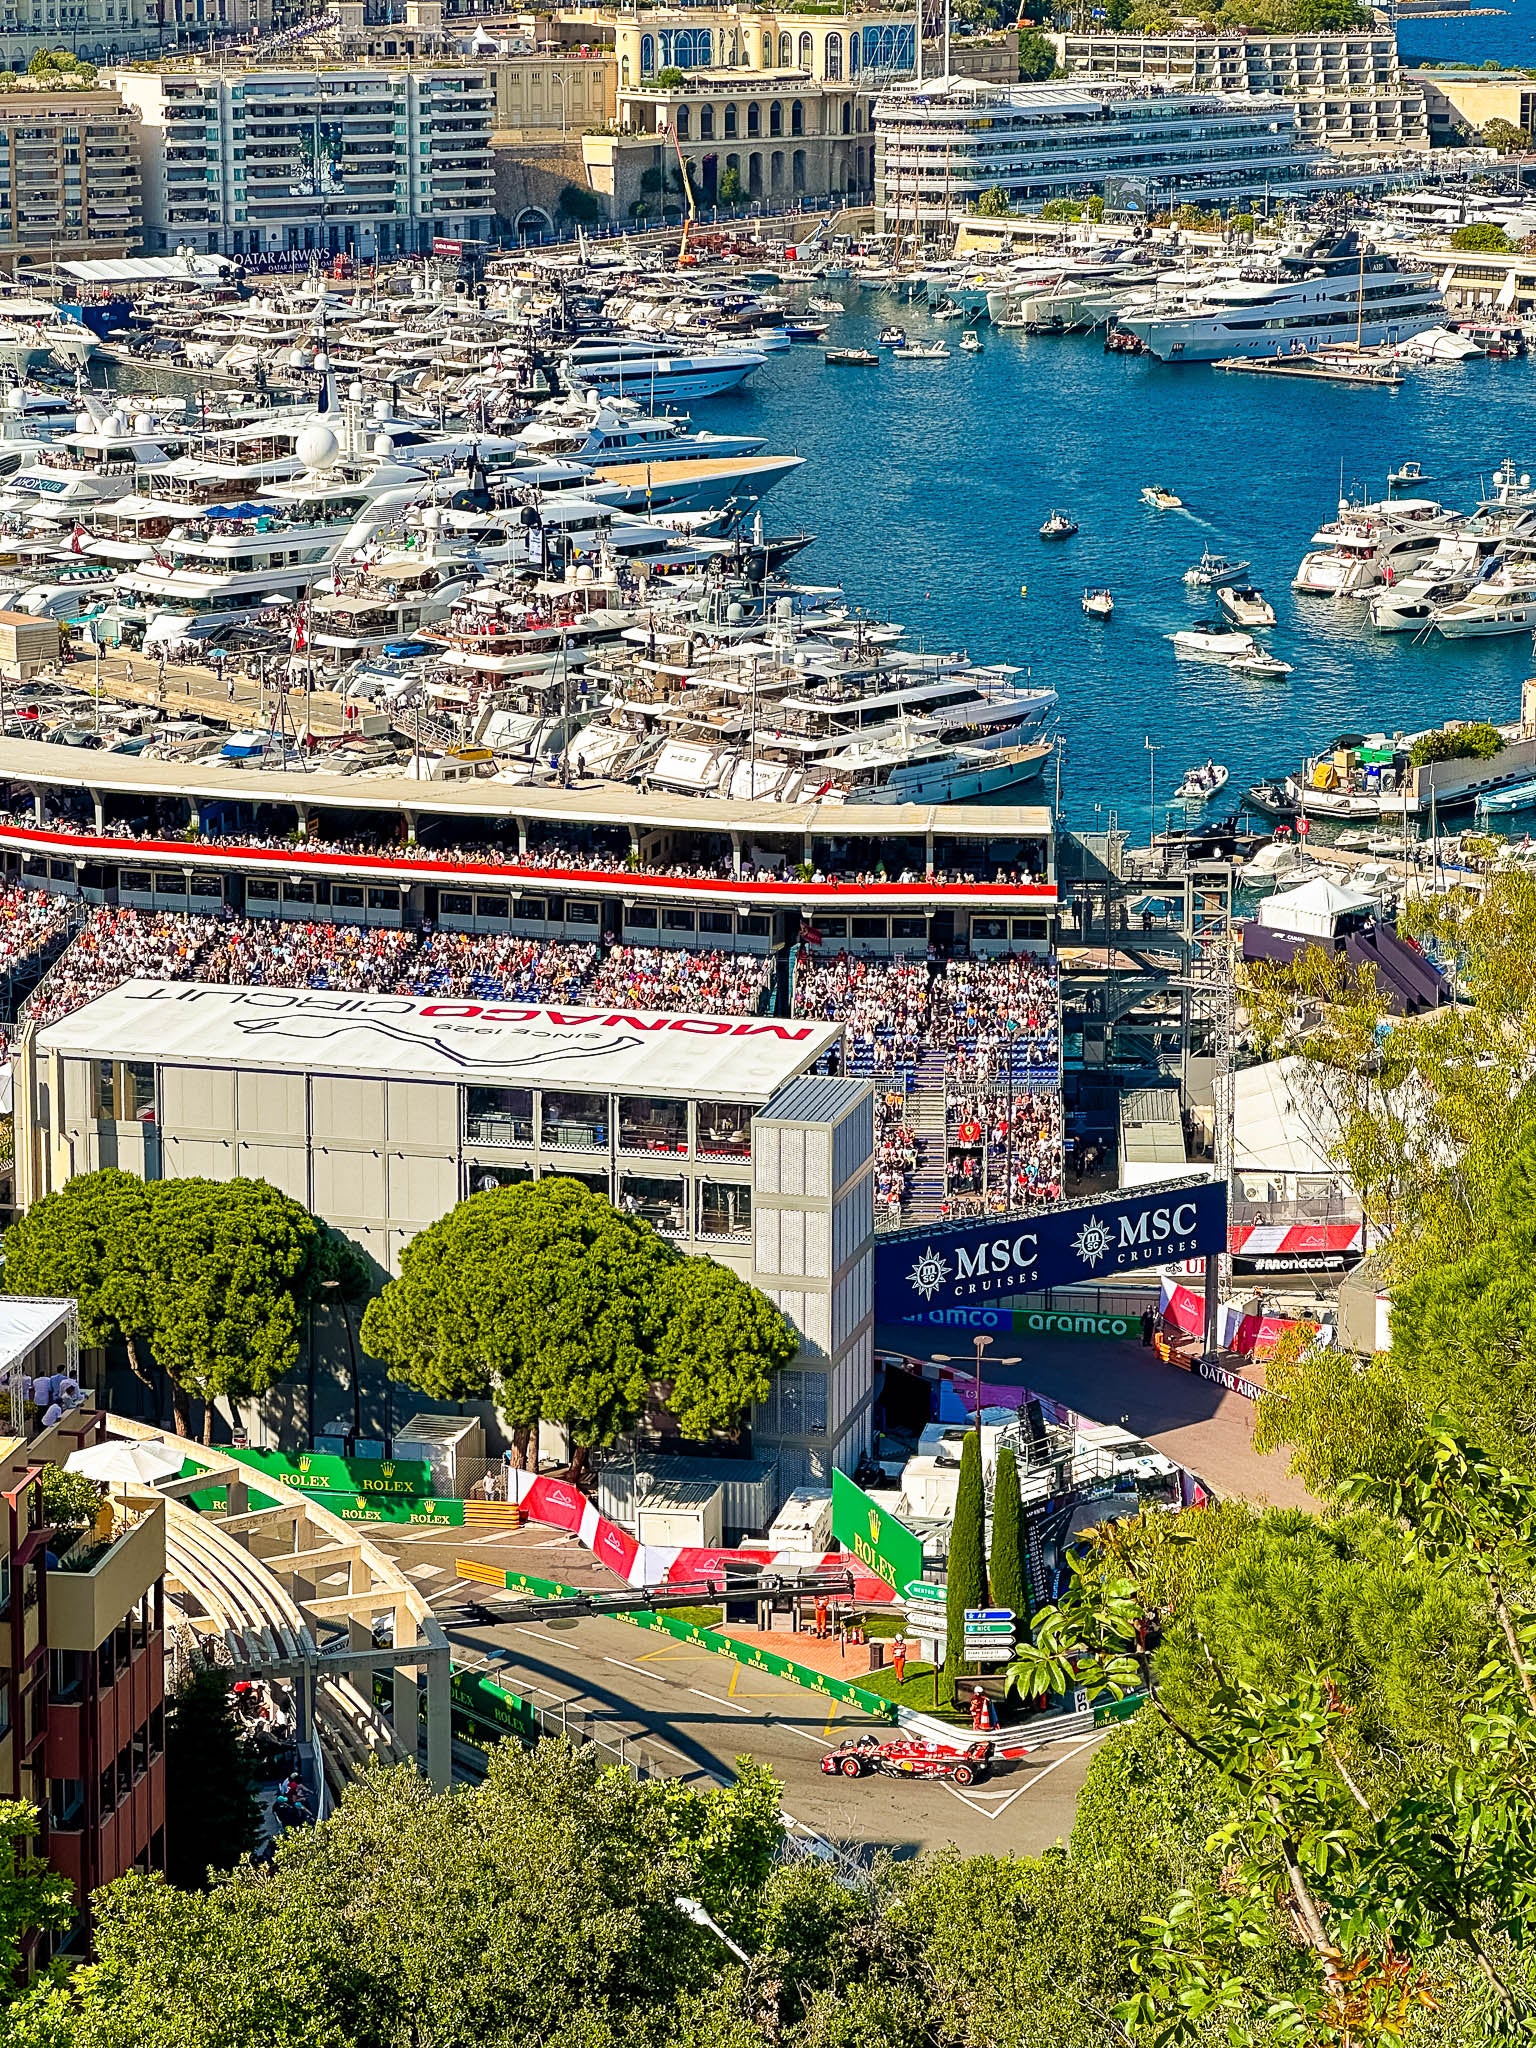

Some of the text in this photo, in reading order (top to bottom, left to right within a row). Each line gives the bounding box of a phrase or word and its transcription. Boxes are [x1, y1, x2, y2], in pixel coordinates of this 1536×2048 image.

[233, 247, 330, 265] QATAR AIRWAYS
[14, 478, 40, 488] AHOY
[124, 988, 416, 1014] CIRCUIT
[419, 1005, 814, 1041] MONACO
[432, 1023, 601, 1039] SINCE 1929
[1117, 1203, 1197, 1248] MSC
[954, 1234, 1038, 1280] MSC
[1117, 1239, 1198, 1264] CRUISES
[954, 1271, 1039, 1296] CRUISES
[902, 1308, 999, 1327] amco
[1028, 1314, 1128, 1335] aramco
[1200, 1363, 1235, 1390] QATAR
[279, 1473, 330, 1487] ROLEX
[363, 1479, 414, 1492] ROLEX
[342, 1509, 382, 1520] ROLEX
[410, 1513, 450, 1524] ROLEX
[853, 1531, 897, 1589] ROLEX
[511, 1583, 535, 1596] ROLEX
[616, 1612, 639, 1626] ROLEX
[649, 1622, 671, 1636] ROLEX
[685, 1635, 707, 1649] ROLEX
[717, 1646, 738, 1660] ROLEX
[748, 1658, 769, 1672] ROLEX
[780, 1670, 801, 1684] ROLEX
[810, 1682, 831, 1696] ROLEX
[450, 1690, 475, 1708] OLEX
[842, 1694, 863, 1709] ROLEX
[494, 1708, 526, 1734] ROLEX
[873, 1707, 893, 1722] ROLEX
[1095, 1715, 1119, 1728] ROLEX
